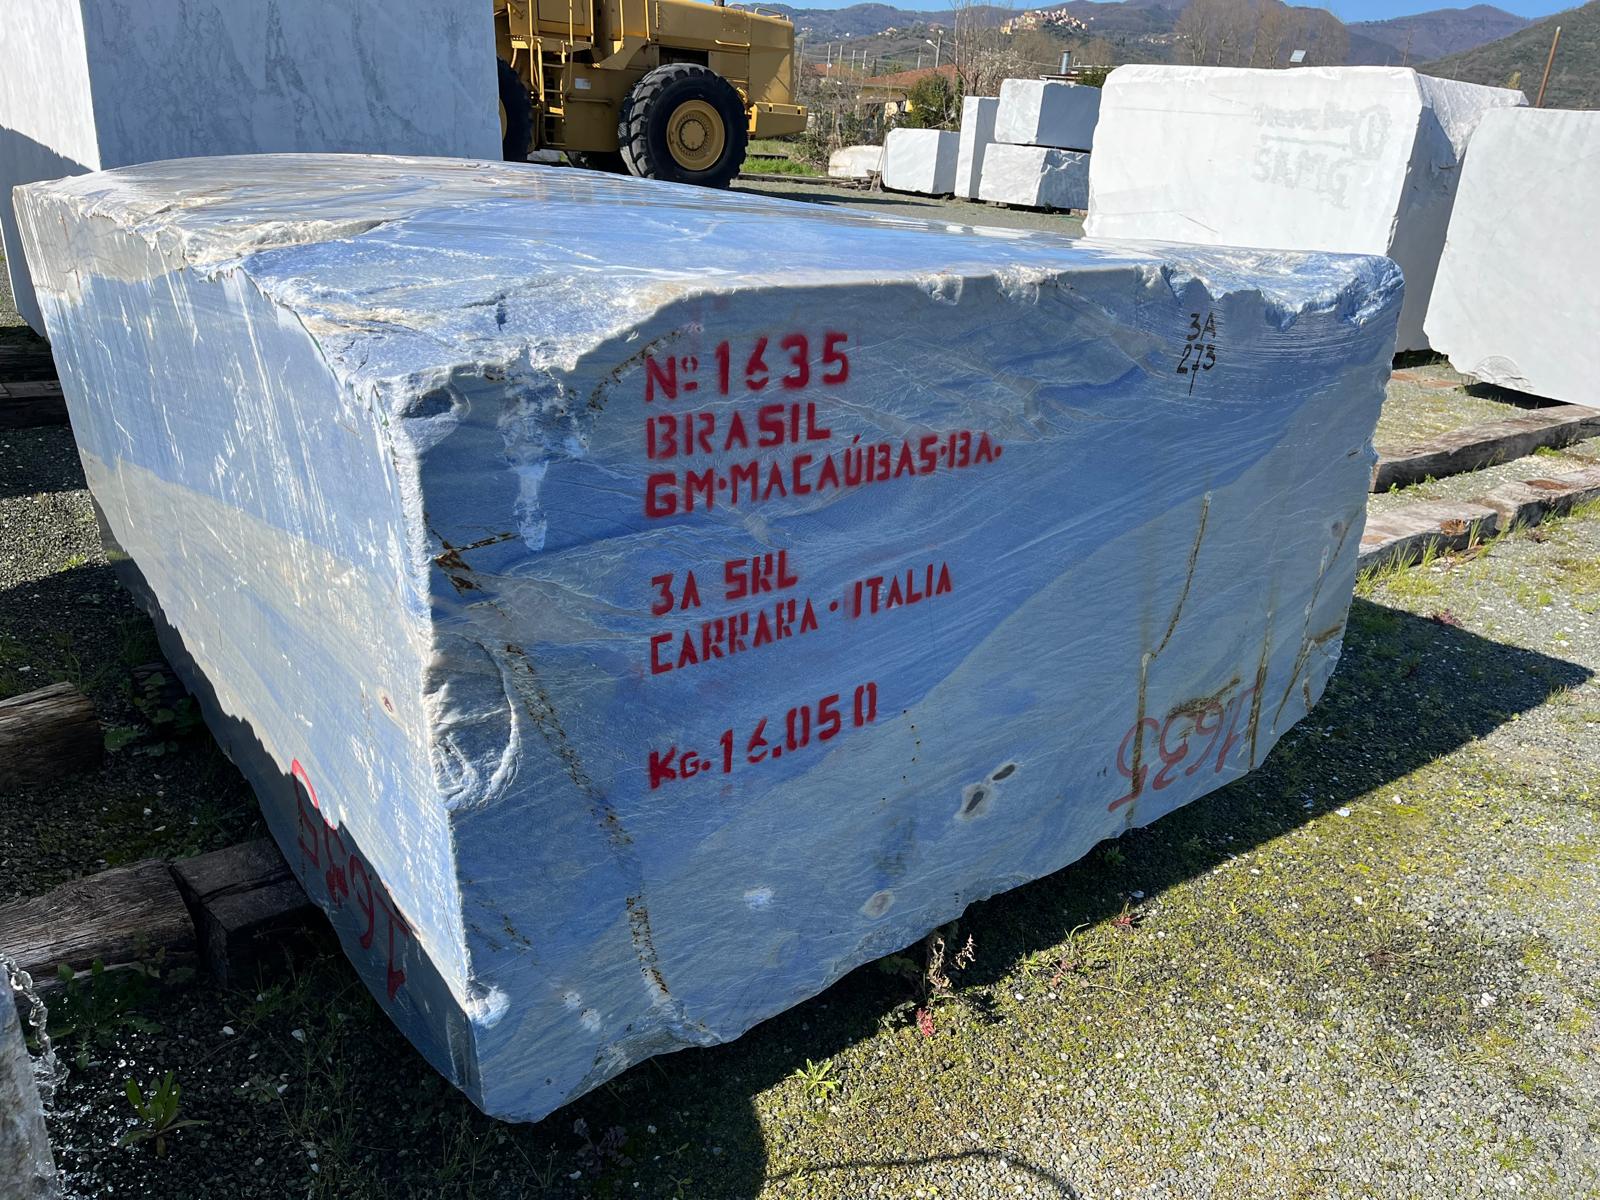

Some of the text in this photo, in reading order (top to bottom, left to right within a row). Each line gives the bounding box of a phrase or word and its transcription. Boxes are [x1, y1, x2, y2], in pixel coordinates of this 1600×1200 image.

[1187, 312, 1217, 341] 3A
[715, 332, 849, 395] 1635
[646, 402, 832, 459] BRASIL
[652, 550, 798, 616] 3A SRL
[651, 598, 818, 675] CARRARA
[853, 561, 952, 619] ITALIA
